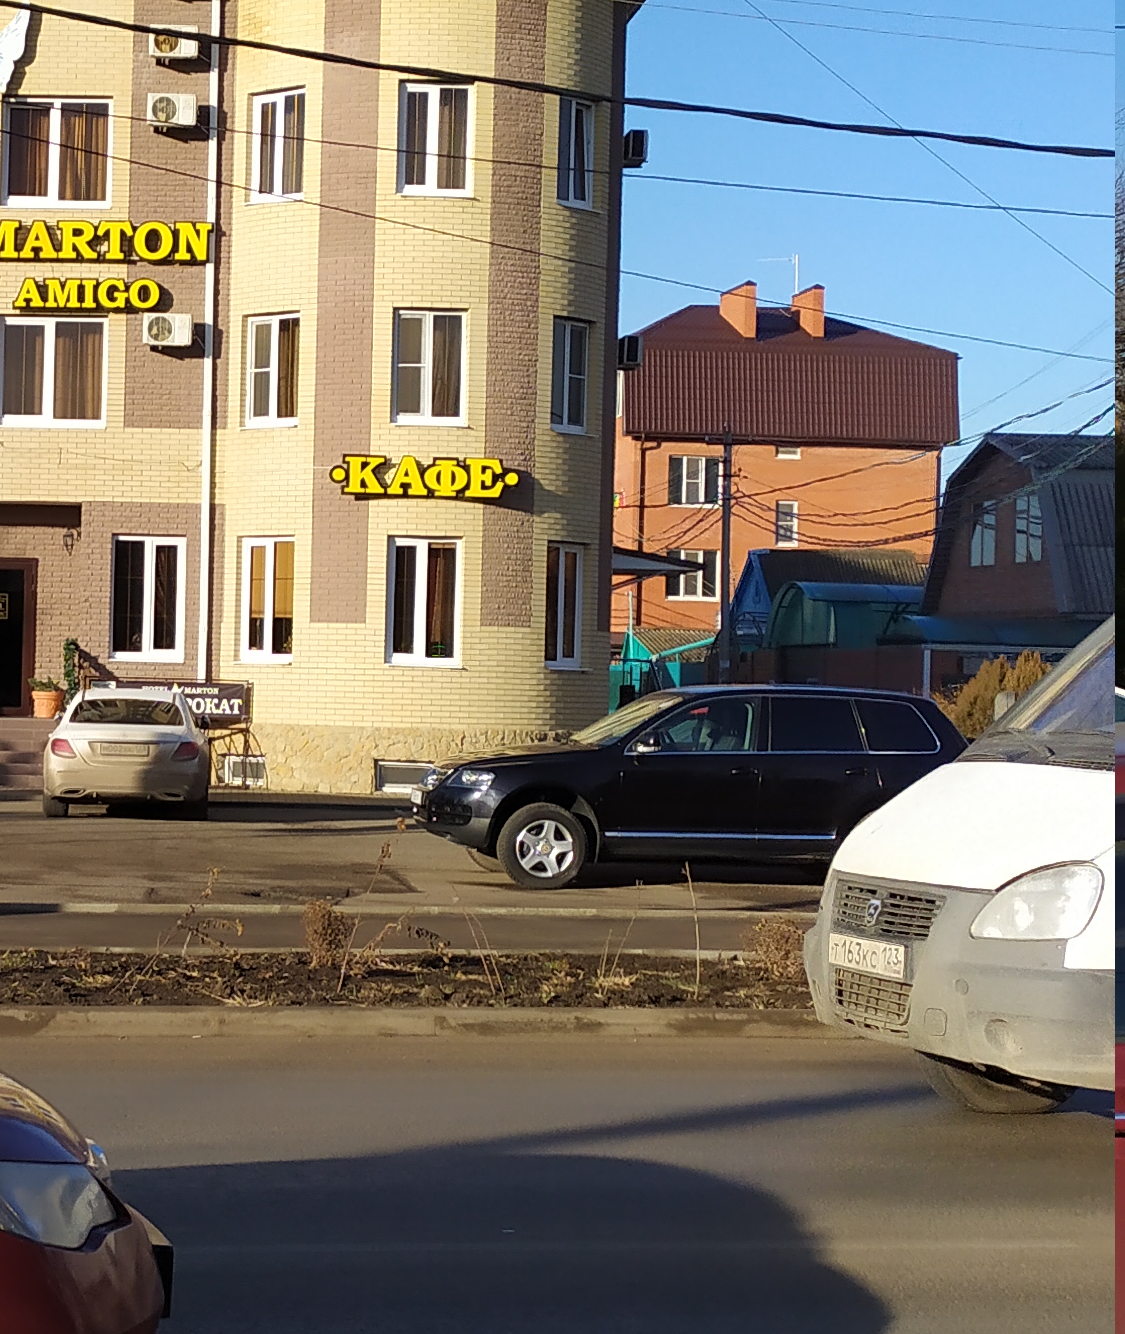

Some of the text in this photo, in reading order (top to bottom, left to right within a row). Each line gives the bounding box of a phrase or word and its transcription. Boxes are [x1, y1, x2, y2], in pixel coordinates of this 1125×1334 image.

[13, 277, 161, 309] AMIGO
[343, 454, 505, 498] КАФЕ
[183, 686, 219, 695] MARTON
[881, 946, 900, 967] 123
